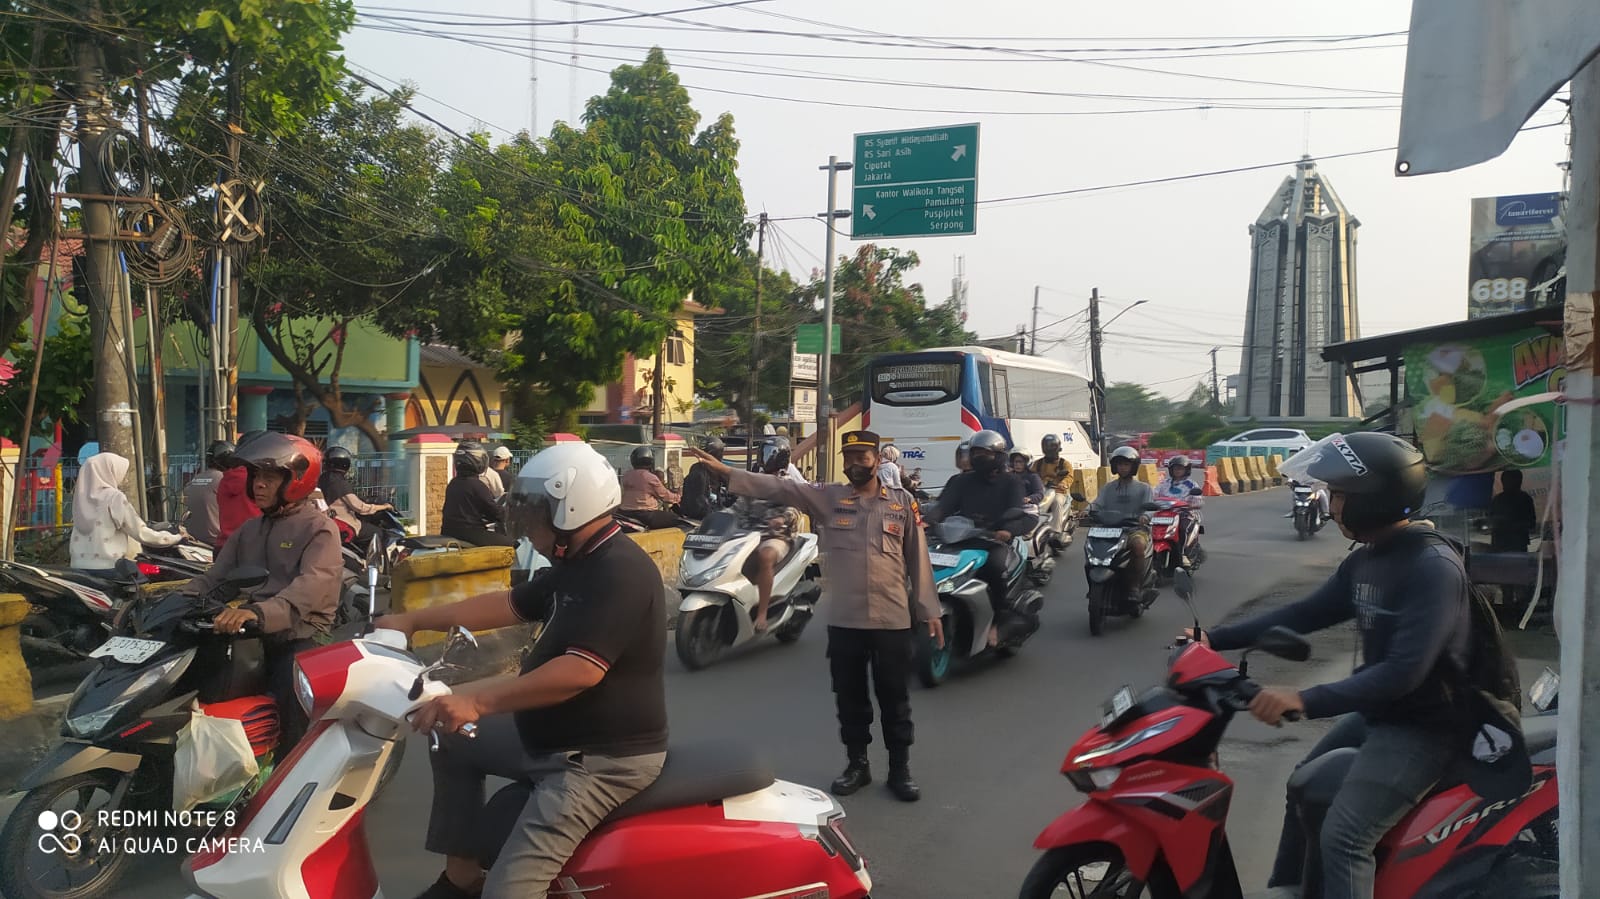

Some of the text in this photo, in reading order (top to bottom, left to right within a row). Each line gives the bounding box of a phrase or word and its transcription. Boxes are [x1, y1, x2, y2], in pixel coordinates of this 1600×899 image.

[864, 147, 912, 158] RS Sari Asih
[864, 160, 891, 170] Ciputat
[864, 173, 892, 181] Jakarta
[876, 185, 965, 198] Kantor Walikota Tangsel
[925, 198, 965, 208] Pamulang
[924, 208, 964, 219] Puspiptek
[930, 221, 964, 231] Serpong
[1471, 277, 1529, 303] 688
[902, 449, 926, 459] TRAC
